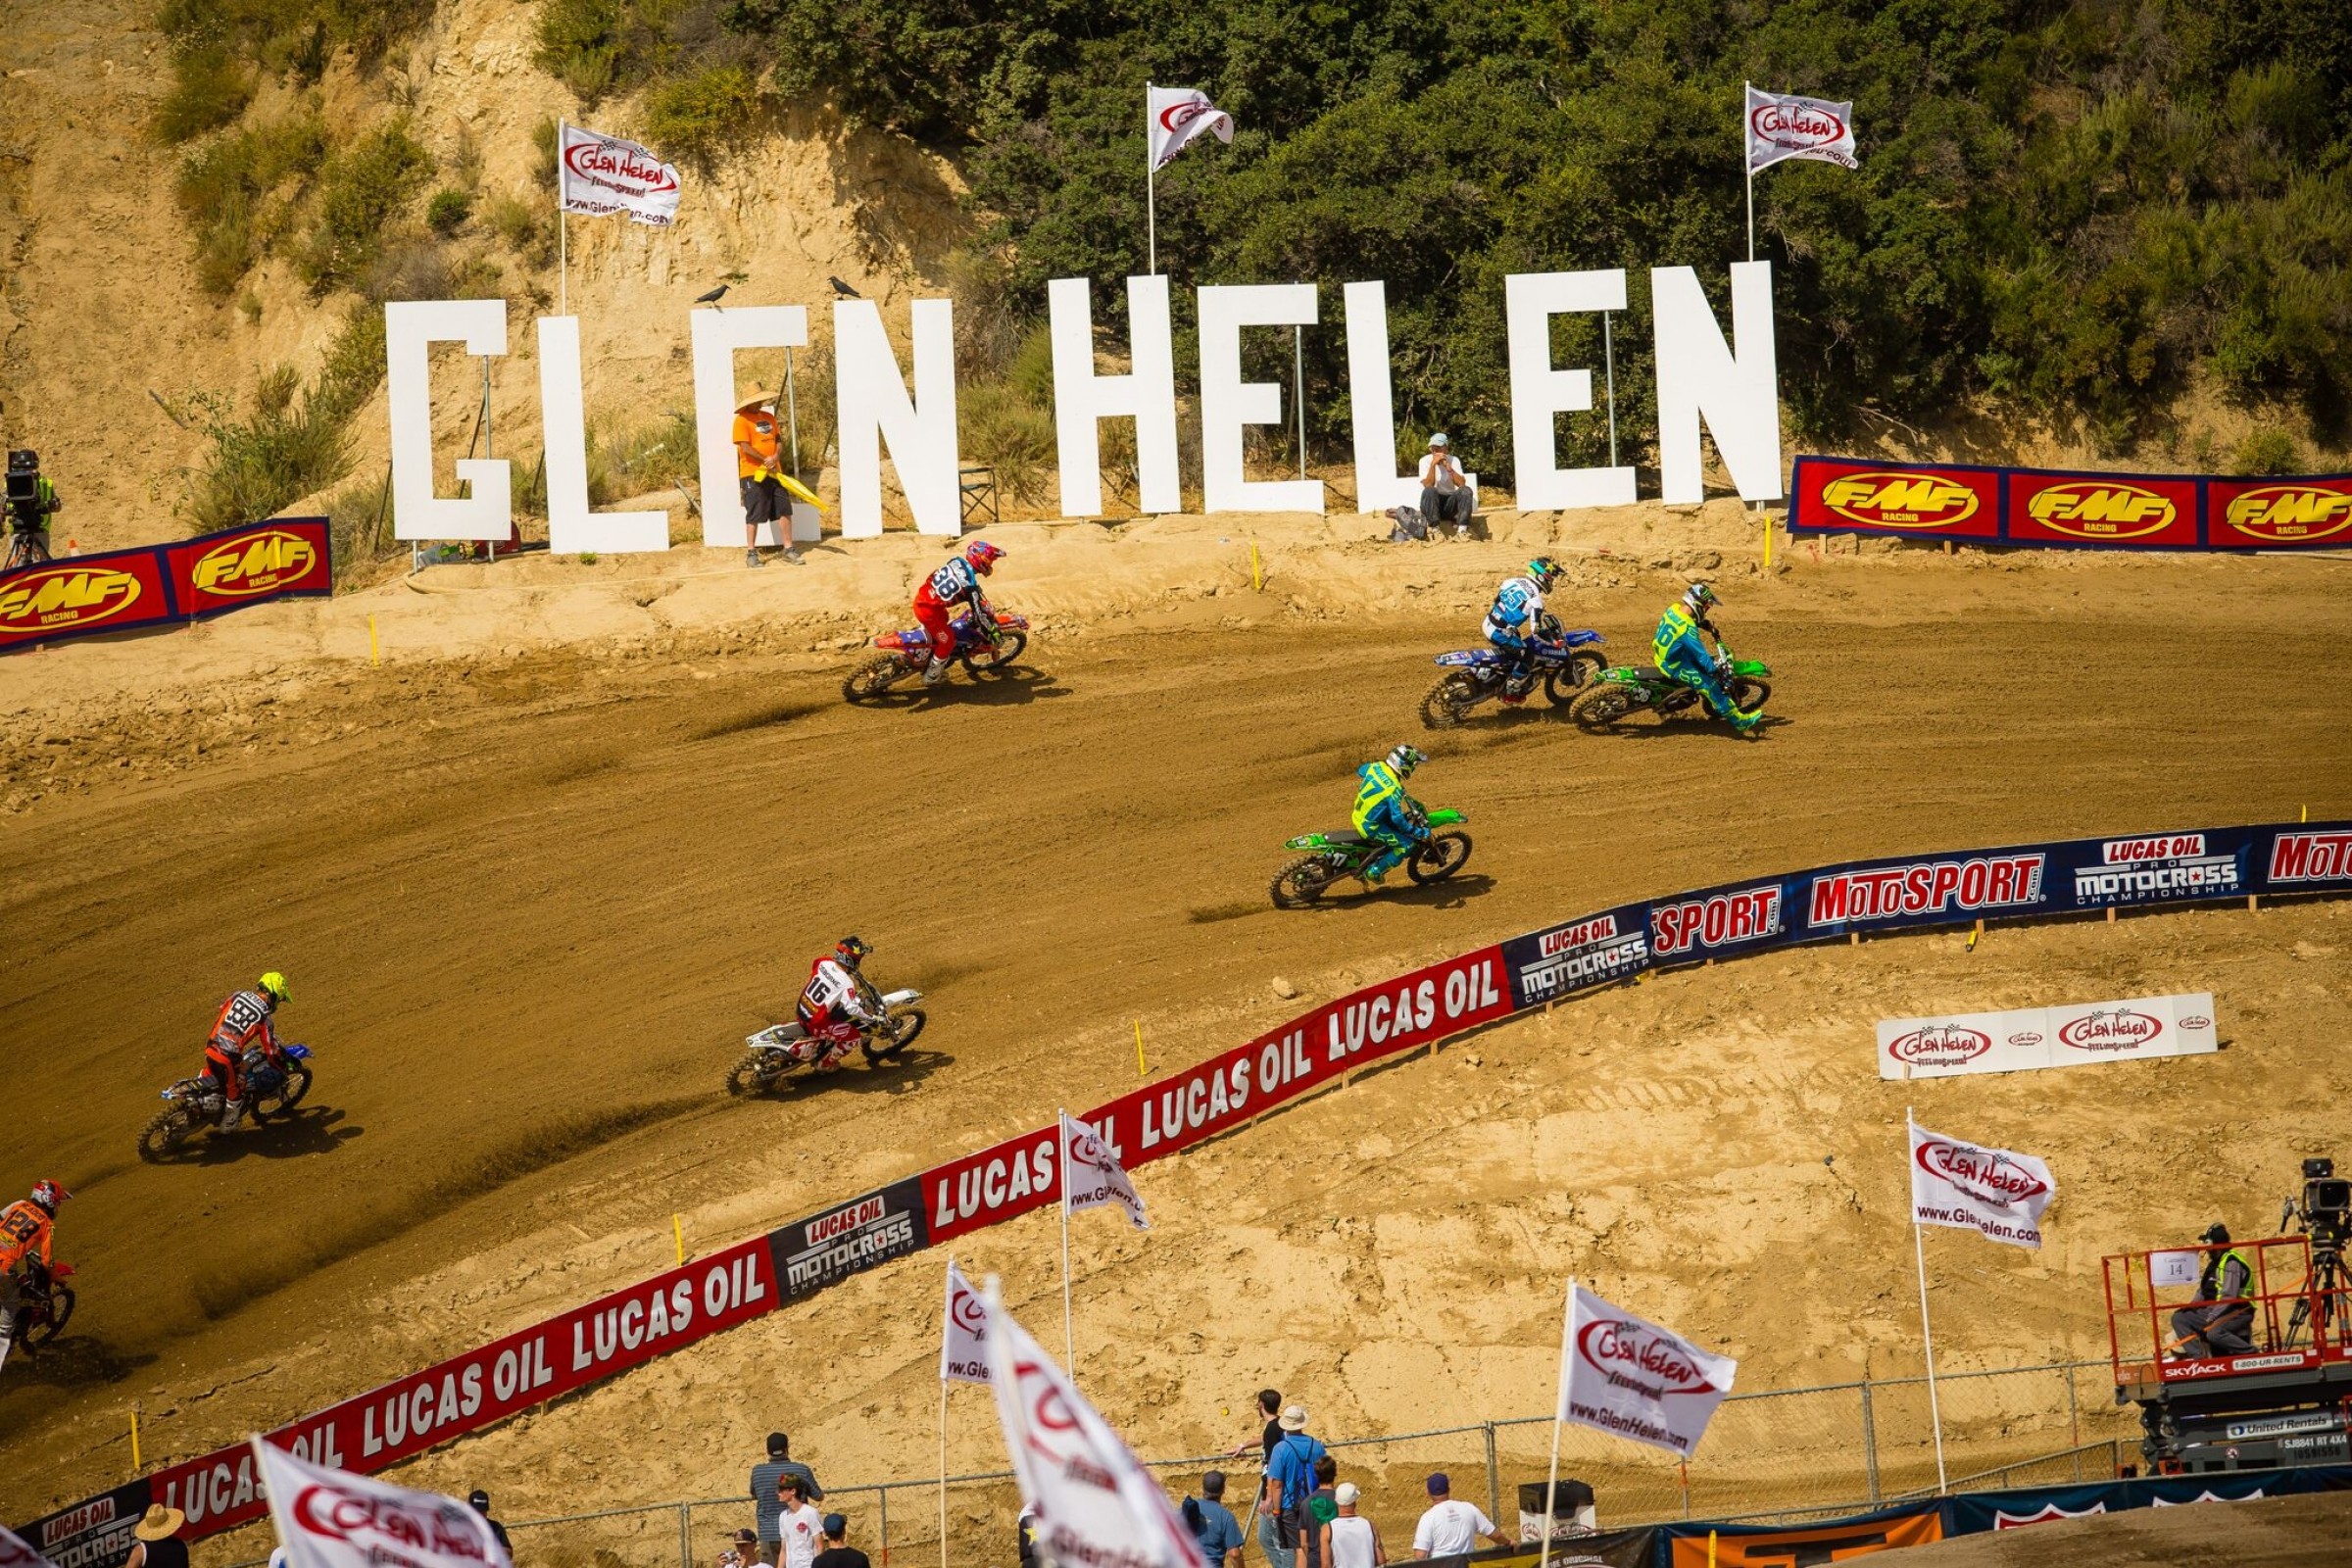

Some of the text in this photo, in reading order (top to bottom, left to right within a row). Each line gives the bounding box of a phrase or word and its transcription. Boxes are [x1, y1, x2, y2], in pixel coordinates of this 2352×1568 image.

[580, 145, 663, 185] GLEN HELEN
[385, 262, 1783, 556] GLEN HELEN
[1824, 480, 1973, 512] FMF
[2030, 490, 2170, 522] FMF
[2228, 493, 2352, 524] FMF
[1882, 513, 1919, 522] RACING
[2083, 523, 2117, 533] RACING
[2276, 525, 2308, 535] RACING
[196, 538, 311, 589] FMF
[0, 572, 132, 620] FMF
[248, 573, 277, 587] RACING
[932, 565, 961, 600] 38
[40, 611, 78, 624] RACING
[1331, 852, 1348, 867] 17
[2109, 837, 2201, 862] LUCAS OIL
[2132, 859, 2178, 871] PRO
[2076, 863, 2238, 896] MOTOCROSS
[2077, 883, 2239, 905] CHAMPIONSHIP
[1545, 917, 1614, 956] LUCAS OIL
[1564, 945, 1596, 960] PRO
[1522, 939, 1647, 995] MOTOCROSS
[1525, 958, 1649, 1004] CHAMPIONSHIP
[807, 977, 831, 1004] 16
[1328, 959, 1499, 1061] LUCAS OIL
[1904, 1029, 1977, 1055] GLEN HELEN
[2075, 1013, 2147, 1041] GLEN HELEN
[1142, 1030, 1312, 1149] LUCAS OIL
[935, 1140, 1054, 1228] LUCAS
[1935, 1147, 1977, 1181] GLEN
[1979, 1154, 2030, 1195] HELEN
[4, 1211, 40, 1244] 28
[811, 1198, 882, 1244] LUCAS OIL
[832, 1227, 865, 1247] PRO
[787, 1218, 913, 1287] MOTOCROSS
[790, 1240, 914, 1295] CHAMPIONSHIP
[2170, 1264, 2183, 1275] 14
[572, 1252, 765, 1372] LUCAS OIL
[1638, 1338, 1692, 1384] HELEN
[2165, 1362, 2227, 1377] SKYJACK
[364, 1337, 553, 1456] LUCAS OIL
[2247, 1416, 2328, 1435] United Rentals
[2317, 1436, 2328, 1446] RT
[2329, 1435, 2347, 1446] 4X4
[47, 1499, 113, 1544] LUCAS OIL
